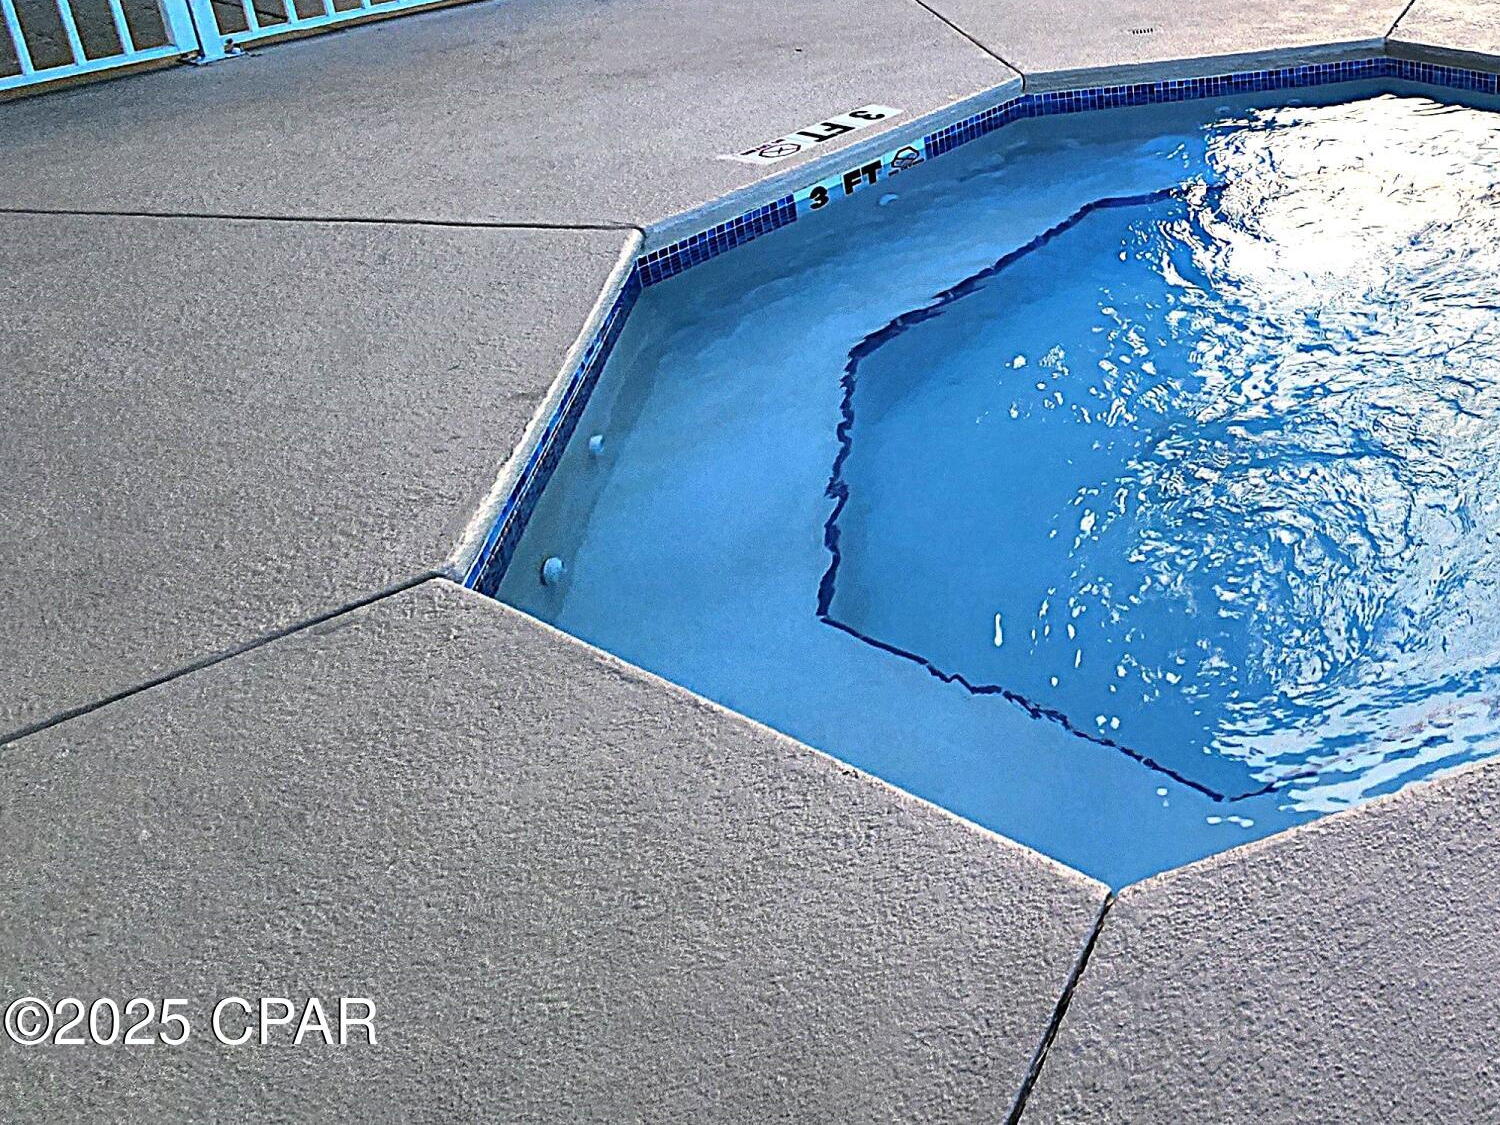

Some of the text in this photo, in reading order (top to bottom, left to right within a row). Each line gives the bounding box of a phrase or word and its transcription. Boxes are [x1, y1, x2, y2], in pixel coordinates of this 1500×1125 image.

[796, 110, 885, 142] 3 FT
[809, 185, 829, 210] 3
[843, 160, 882, 194] FT
